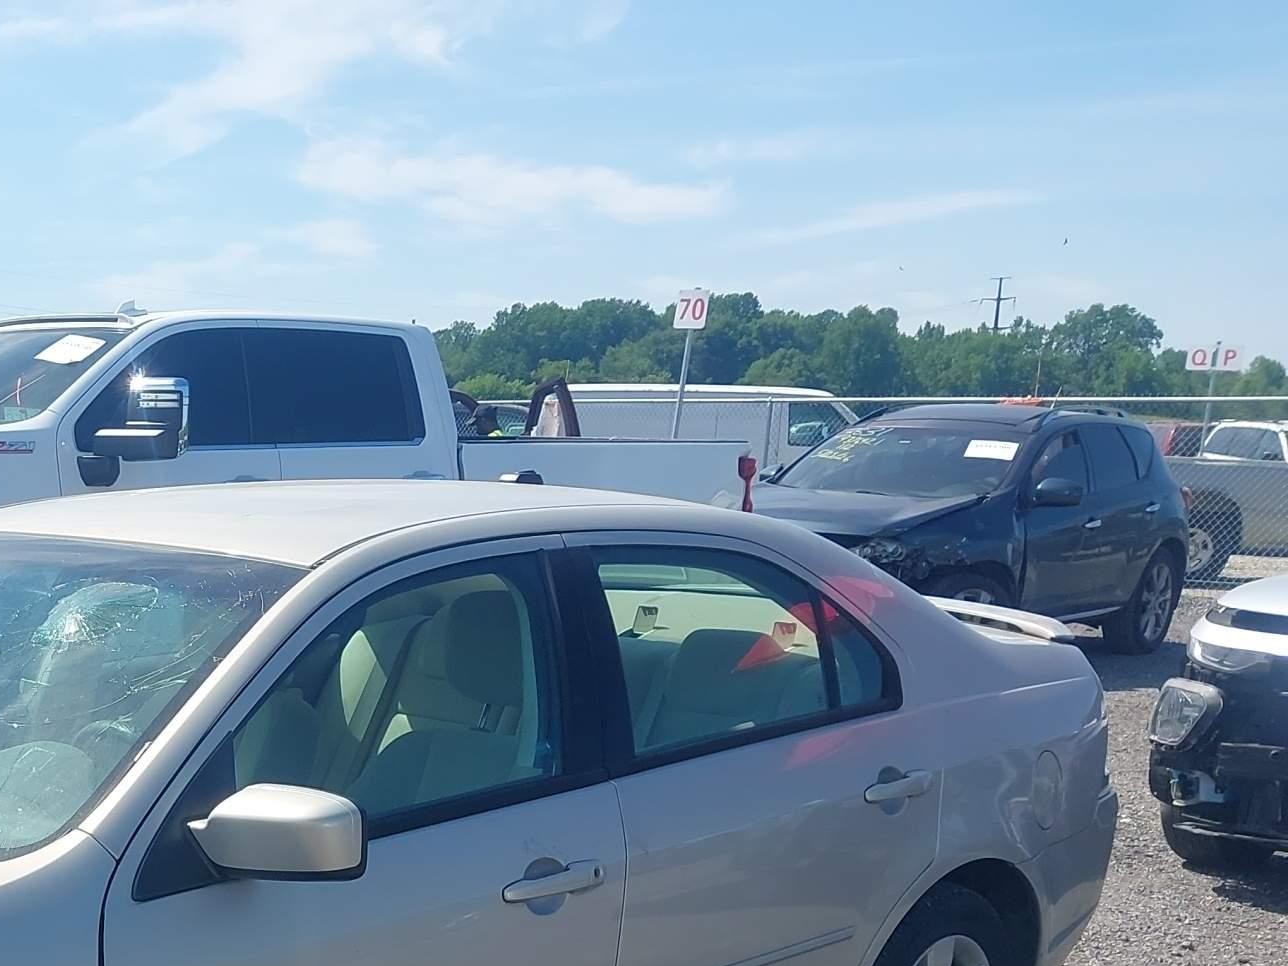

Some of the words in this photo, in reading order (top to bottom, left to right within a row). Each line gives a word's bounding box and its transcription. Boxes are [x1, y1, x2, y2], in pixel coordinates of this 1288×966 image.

[679, 298, 705, 320] 70
[1192, 349, 1207, 365] Q
[1224, 349, 1237, 366] P
